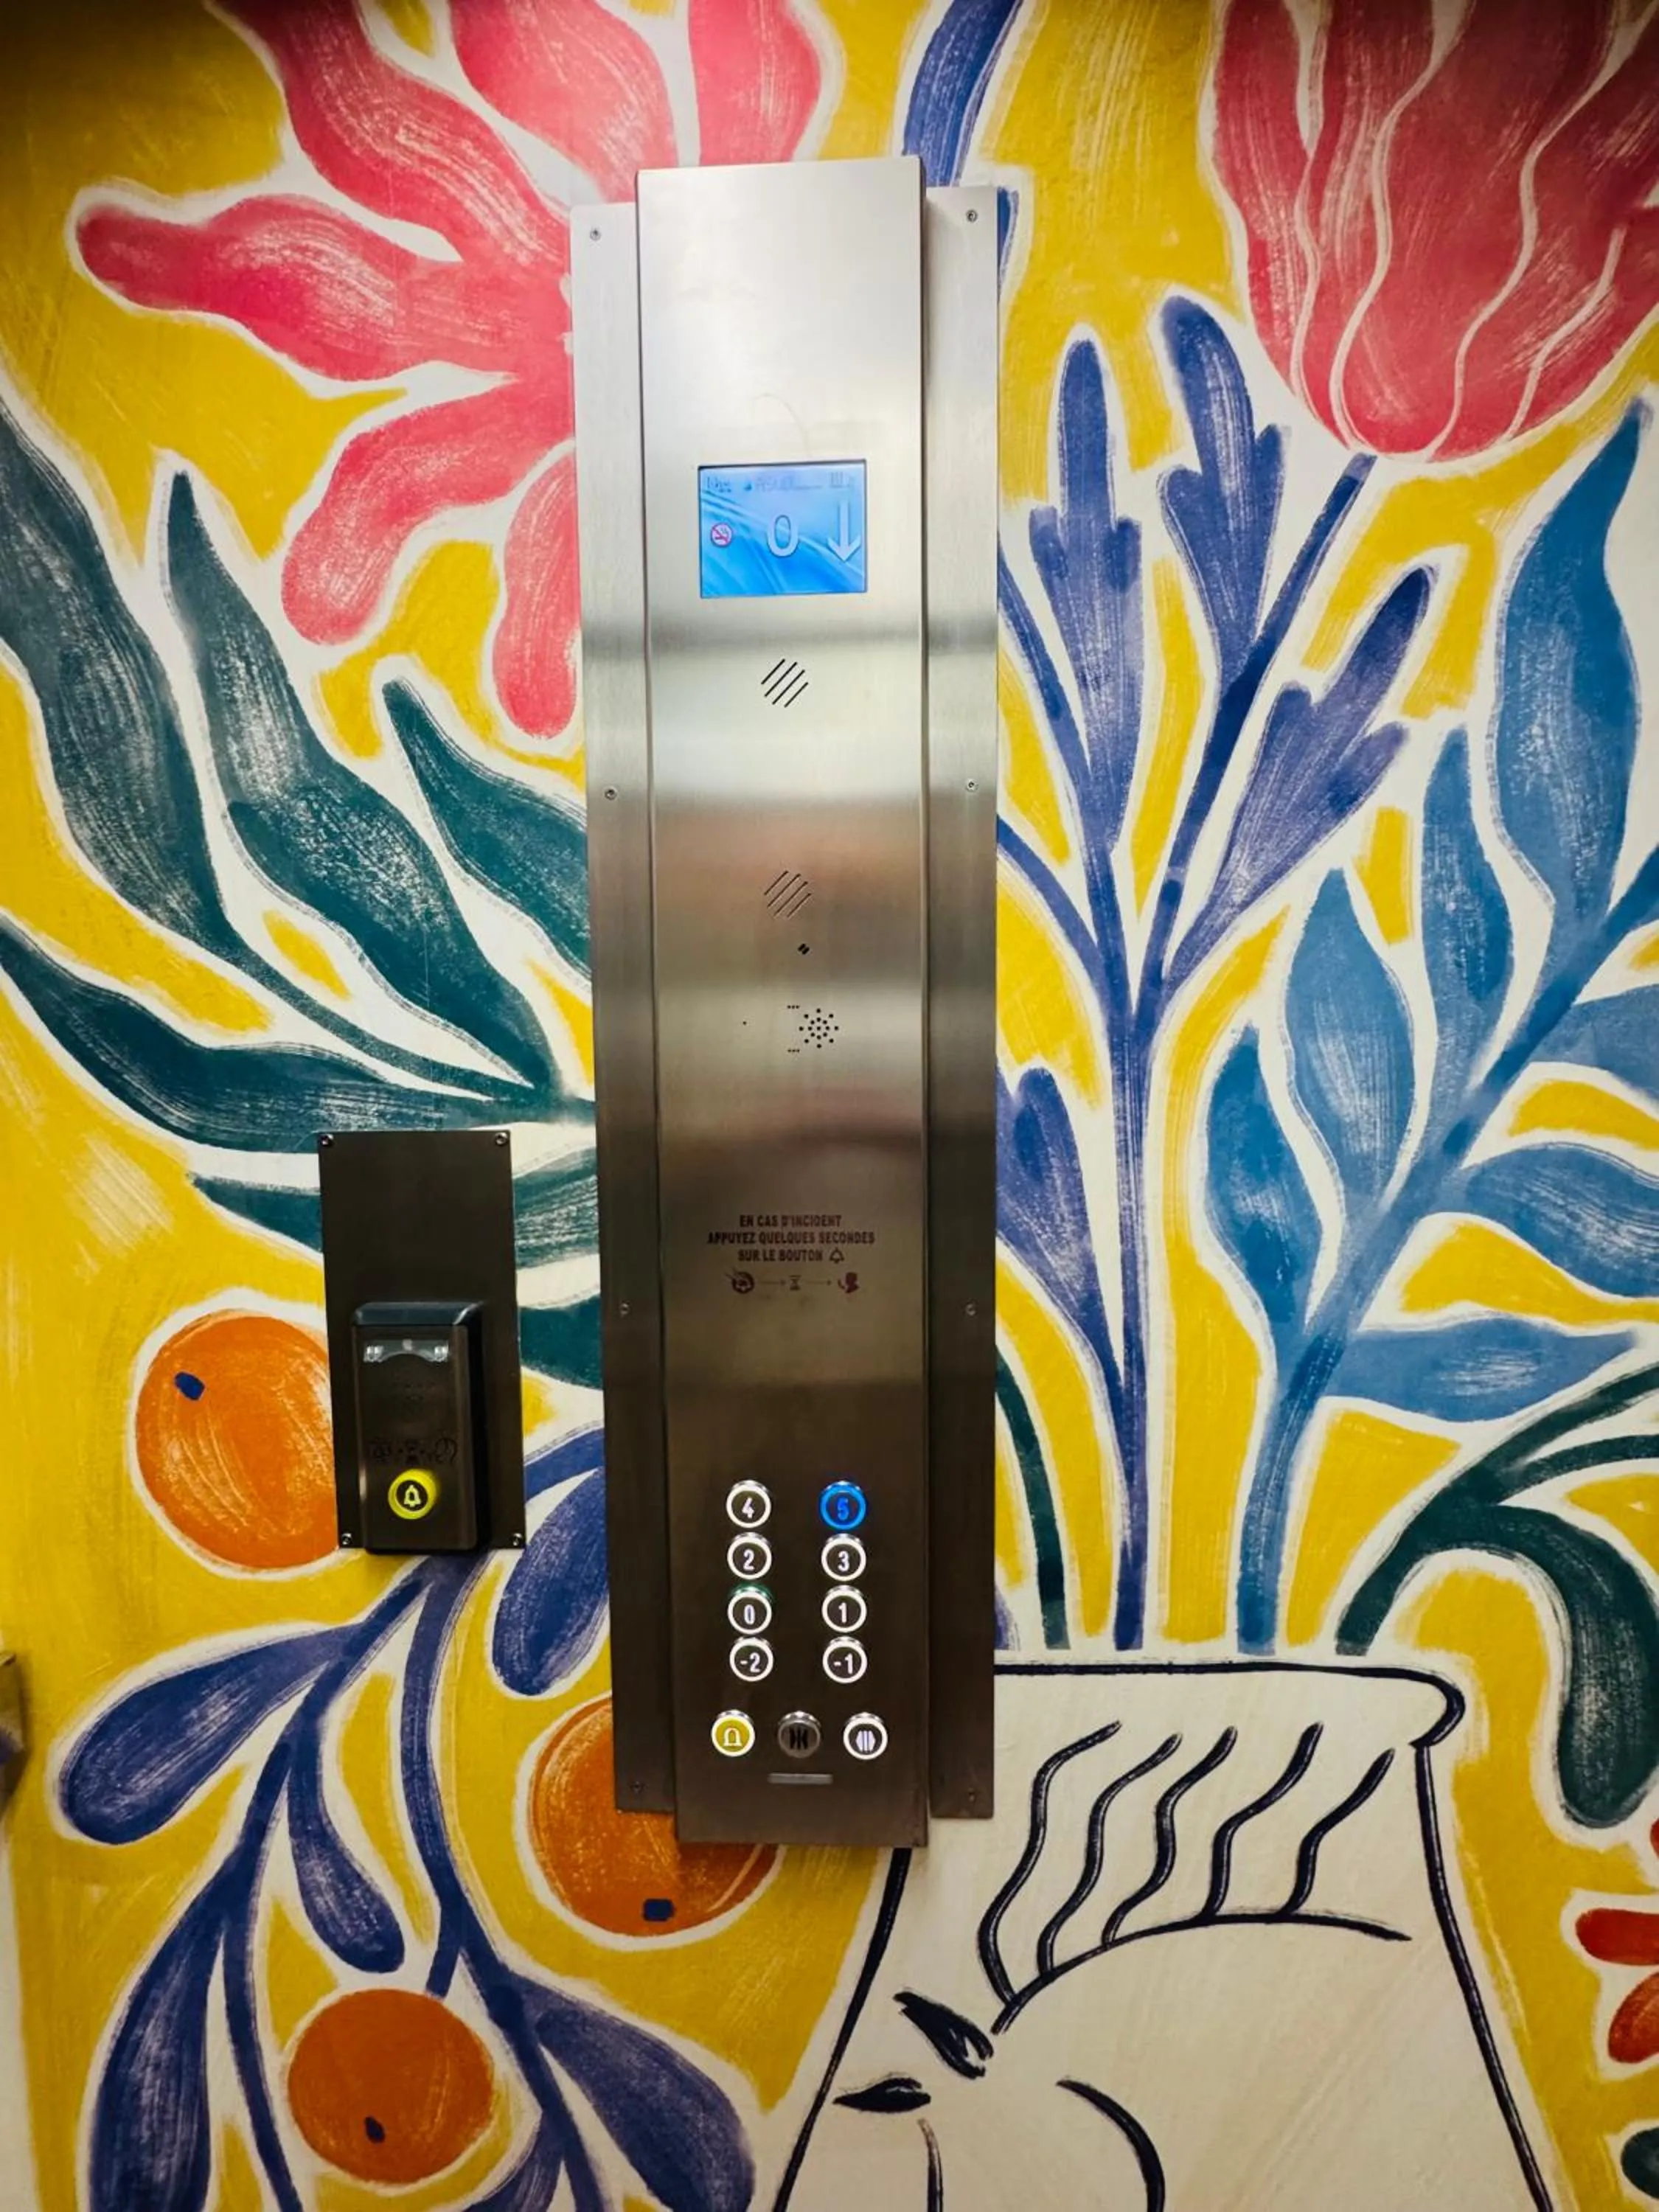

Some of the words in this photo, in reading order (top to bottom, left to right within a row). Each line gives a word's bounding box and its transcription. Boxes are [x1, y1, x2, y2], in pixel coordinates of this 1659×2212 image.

[767, 512, 799, 558] 0
[740, 1215, 754, 1228] EN
[757, 1215, 779, 1228] CAS
[781, 1214, 842, 1228] D'INCIDENT
[707, 1232, 756, 1245] APPUYEZ
[759, 1231, 815, 1245] QUELQUES
[819, 1231, 875, 1245] SECONDES
[737, 1249, 759, 1262] SUR
[763, 1249, 774, 1262] LE
[779, 1249, 823, 1262] BOUTON
[742, 1497, 754, 1519] 4
[837, 1500, 850, 1521] 5
[743, 1549, 754, 1571] 2
[838, 1551, 850, 1573] 3
[743, 1604, 756, 1625] 0
[838, 1601, 847, 1624] 1
[740, 1652, 761, 1673] -2
[833, 1652, 853, 1674] -1
